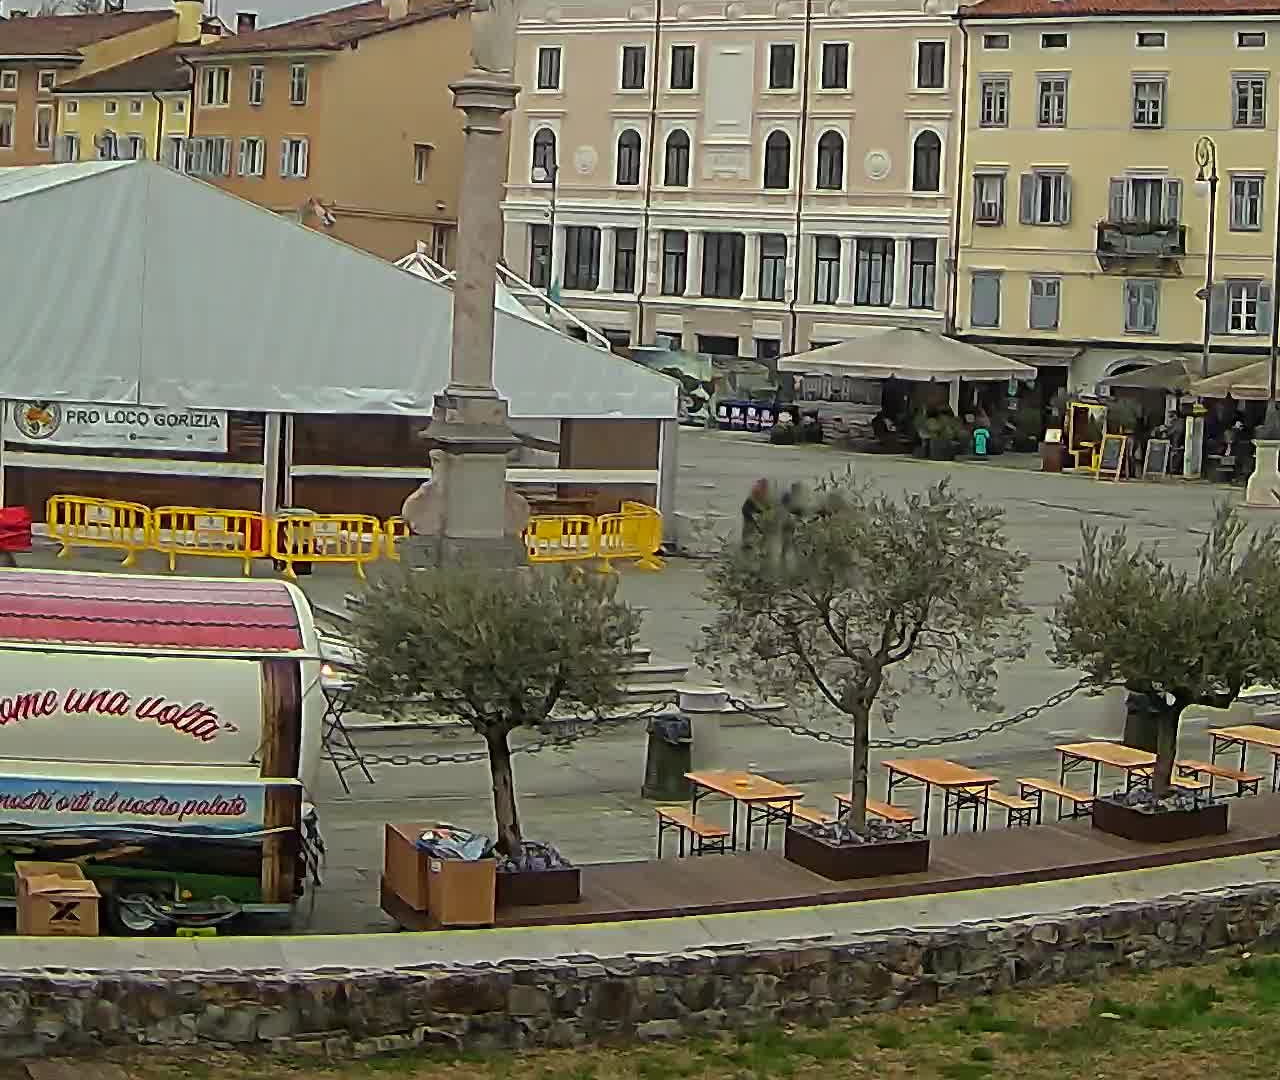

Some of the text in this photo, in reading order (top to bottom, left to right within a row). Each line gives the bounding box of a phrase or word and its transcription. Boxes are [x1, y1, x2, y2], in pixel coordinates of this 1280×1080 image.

[66, 410, 220, 428] PRO LOCO GORIZIA
[64, 688, 131, 717] una
[92, 791, 119, 812] al
[118, 795, 180, 816] vostro
[177, 793, 247, 822] palato
